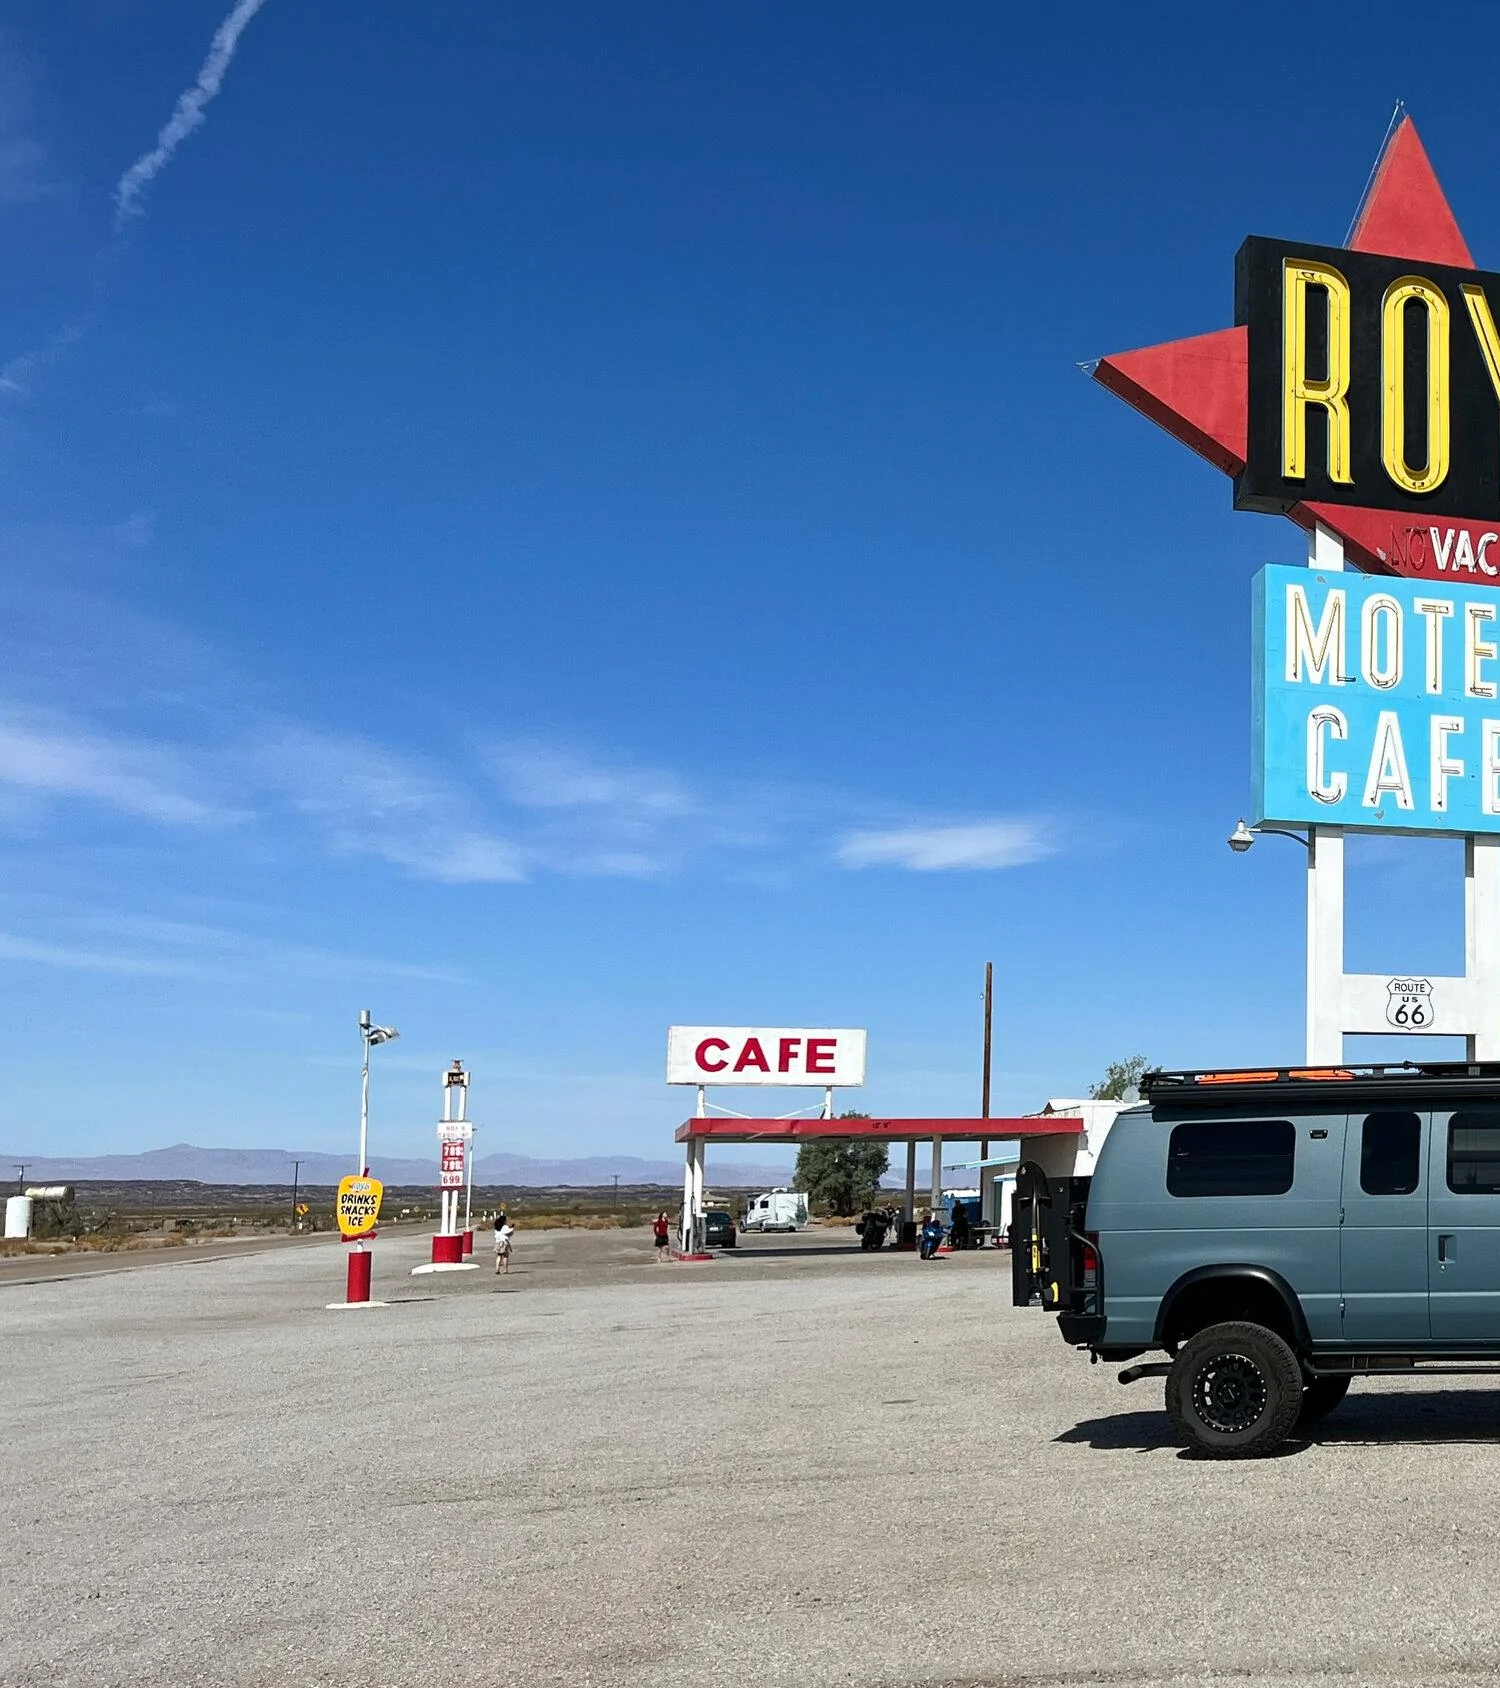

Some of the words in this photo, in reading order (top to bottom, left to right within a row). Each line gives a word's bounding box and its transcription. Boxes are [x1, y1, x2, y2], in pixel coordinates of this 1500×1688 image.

[1390, 525, 1427, 570] NO
[1394, 983, 1426, 993] ROUTE
[1395, 1004, 1425, 1025] 66
[695, 1037, 838, 1074] CAFE
[341, 1194, 377, 1205] DRINKS
[341, 1206, 376, 1216] SNACKS
[348, 1216, 363, 1226] ICE
